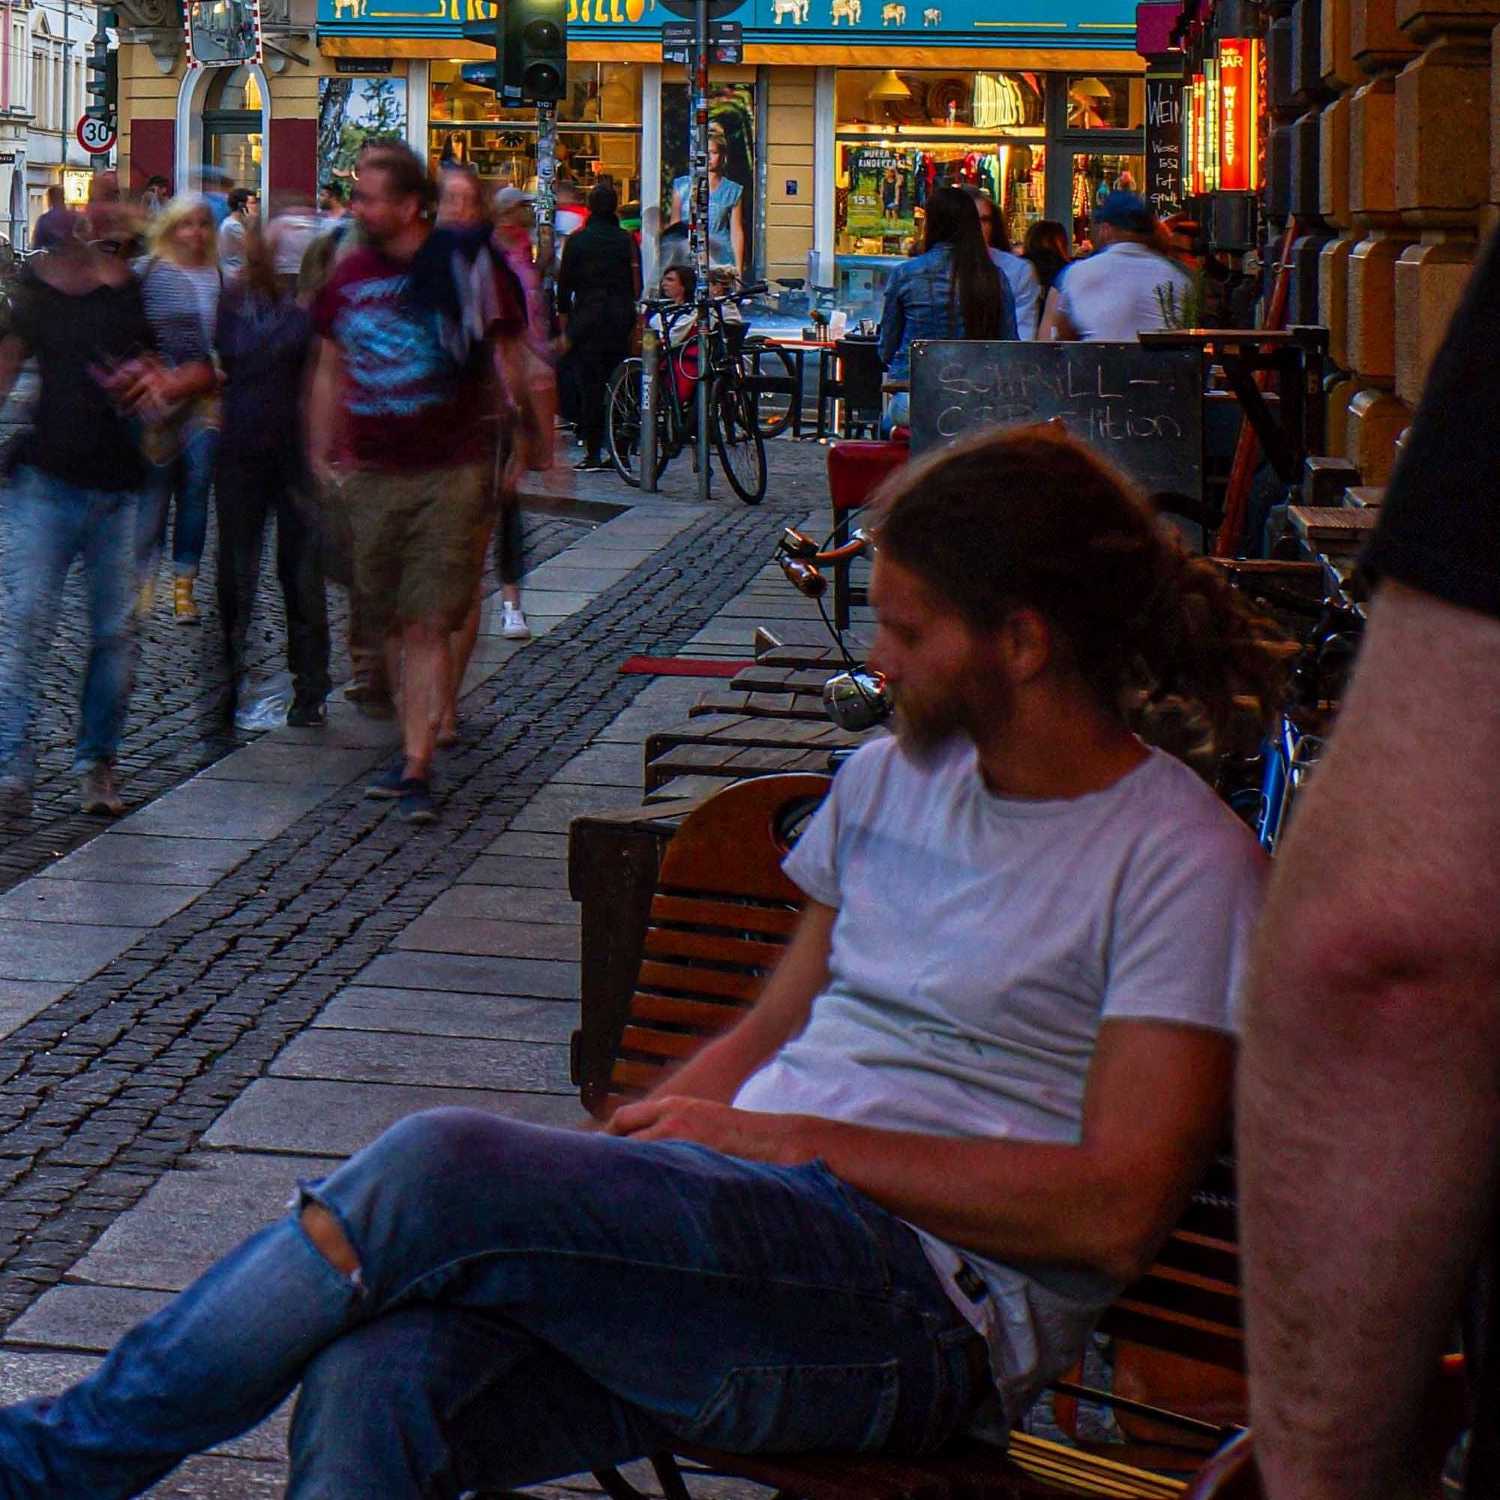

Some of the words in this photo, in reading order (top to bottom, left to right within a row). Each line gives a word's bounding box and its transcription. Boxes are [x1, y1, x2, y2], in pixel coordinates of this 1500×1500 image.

[85, 123, 109, 142] 30
[1223, 86, 1236, 166] WHISKEY
[858, 159, 896, 168] KINDERTA
